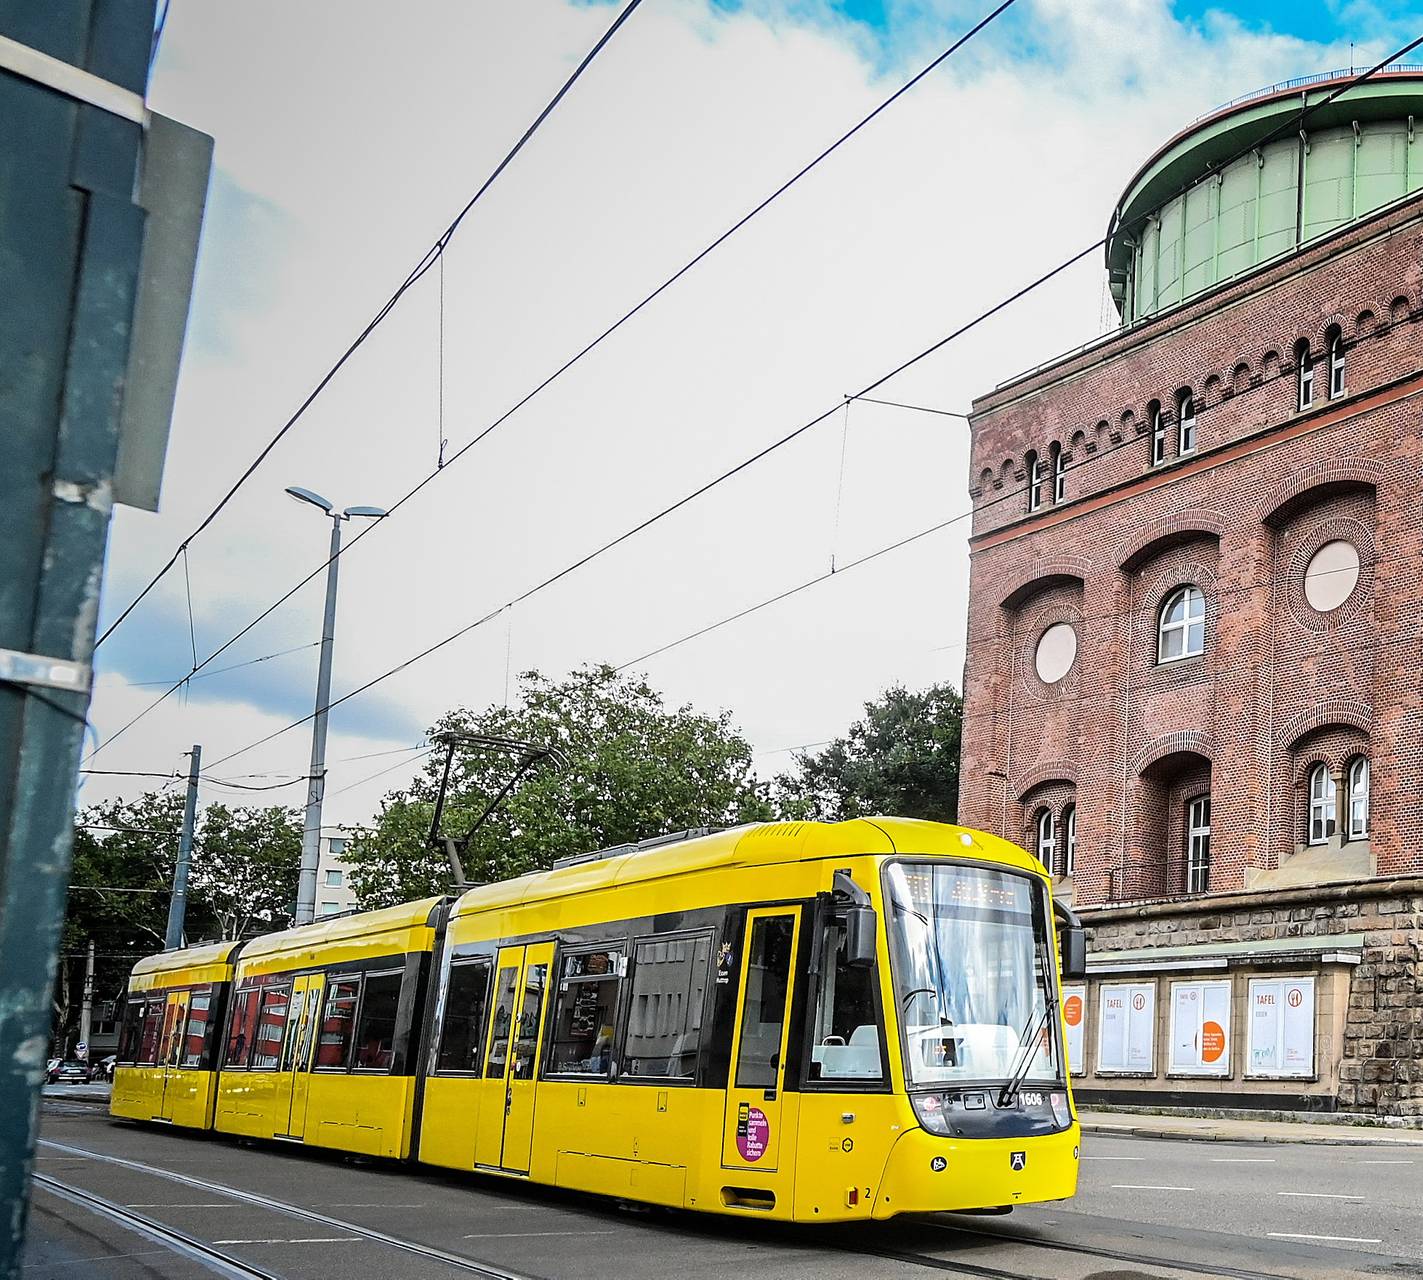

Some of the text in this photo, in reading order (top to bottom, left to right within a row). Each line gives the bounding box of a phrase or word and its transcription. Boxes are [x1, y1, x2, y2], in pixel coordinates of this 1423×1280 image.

[1107, 999, 1123, 1008] TAFEL
[1256, 995, 1275, 1004] TAFEL
[1019, 1092, 1043, 1106] 1606
[865, 1187, 871, 1199] 2
